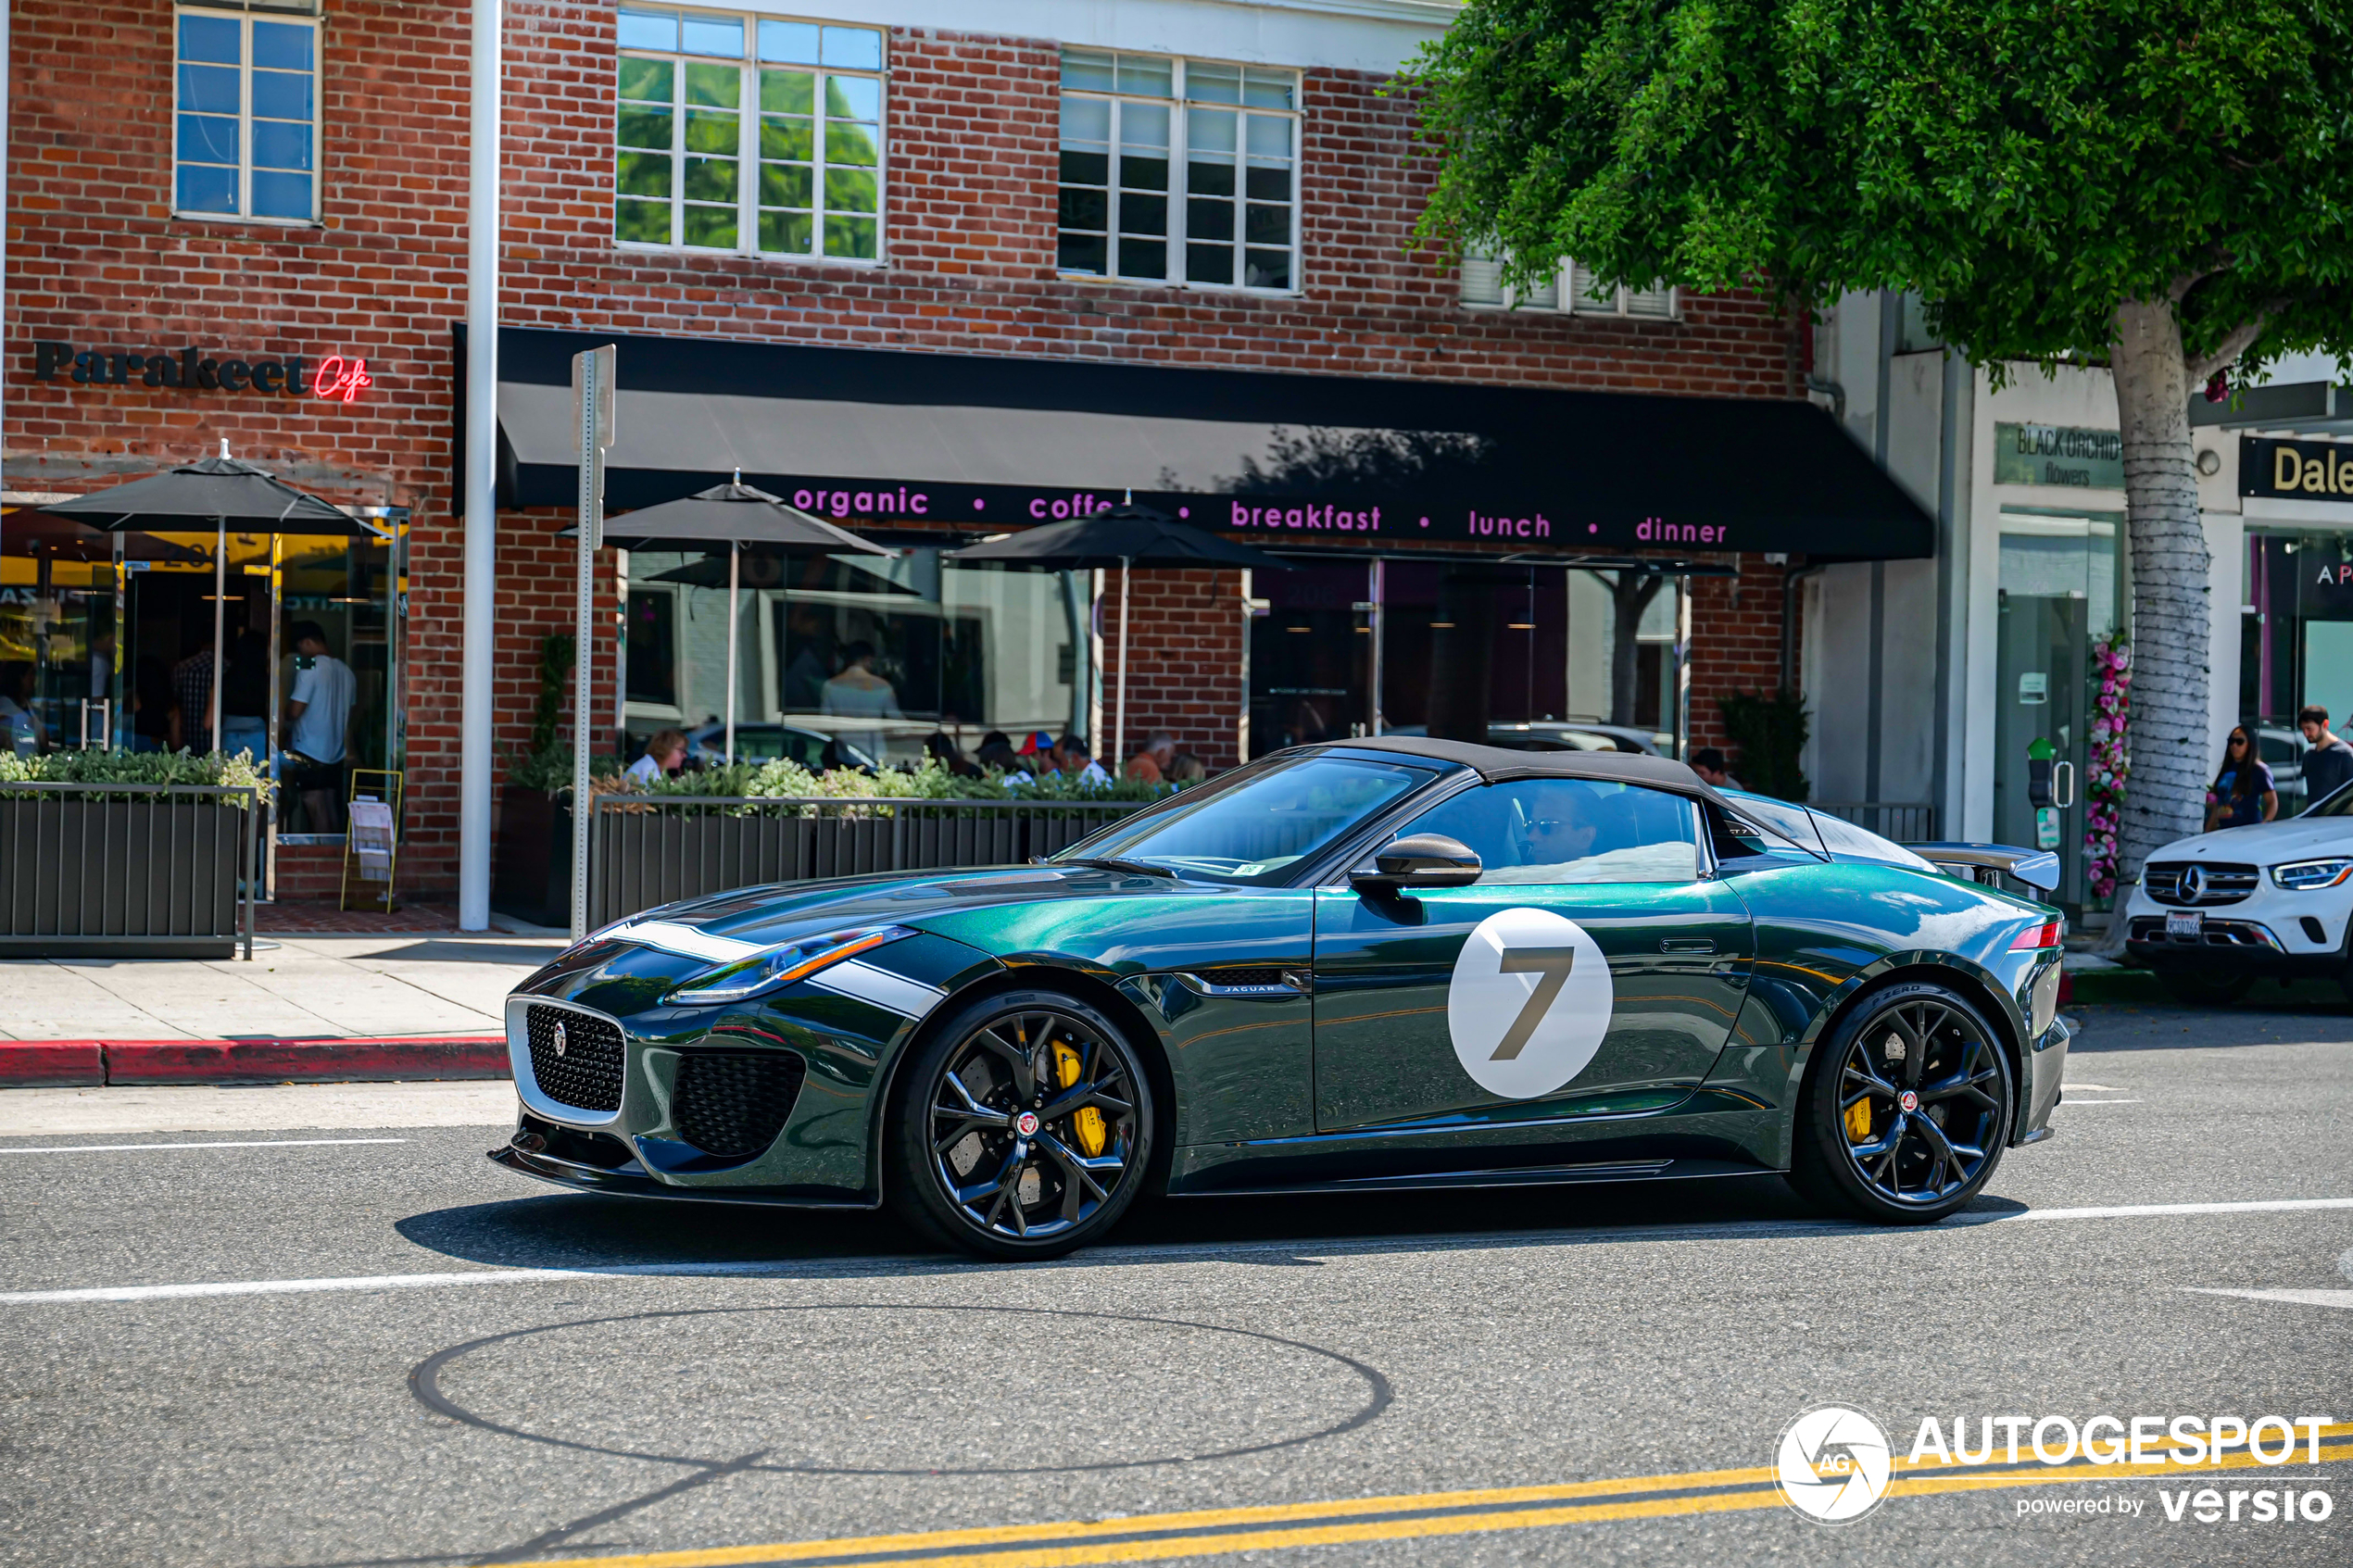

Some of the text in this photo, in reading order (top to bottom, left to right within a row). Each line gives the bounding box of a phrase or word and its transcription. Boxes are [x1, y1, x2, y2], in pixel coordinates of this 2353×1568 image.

[33, 341, 310, 395] Parakeet
[2018, 428, 2119, 460] BLACK ORCHID
[2045, 460, 2090, 486] flowers
[2274, 446, 2353, 495] Dale
[793, 486, 1727, 545] organic coffe breakfast lunch dinner
[164, 543, 230, 569] 206
[2317, 565, 2334, 584] A
[1489, 946, 1575, 1060] 7
[1871, 985, 1920, 1007] P ZERO
